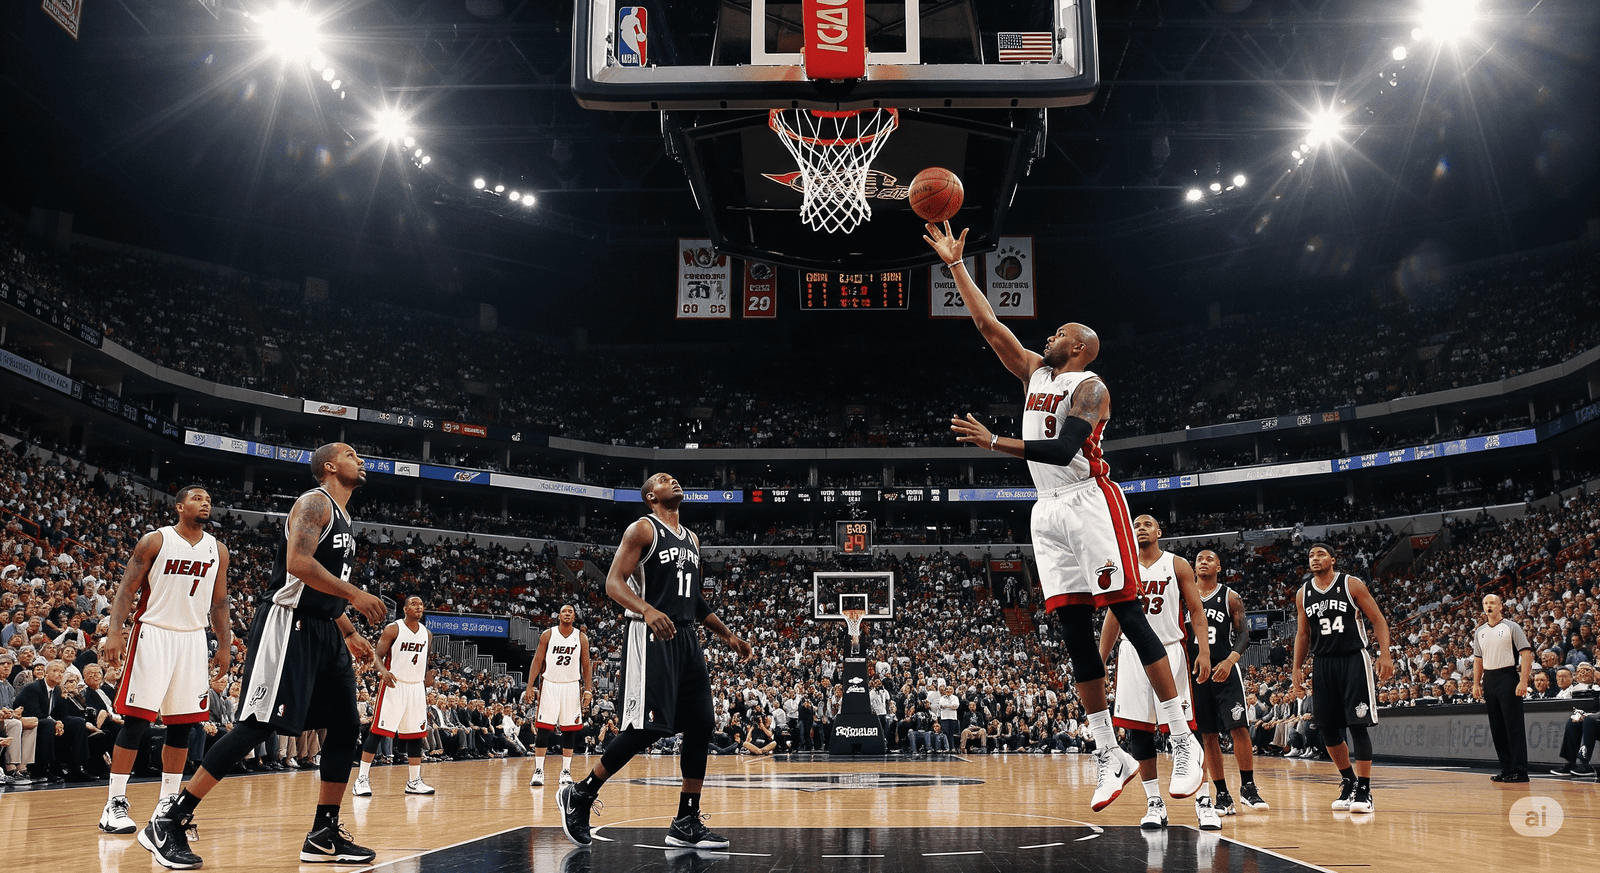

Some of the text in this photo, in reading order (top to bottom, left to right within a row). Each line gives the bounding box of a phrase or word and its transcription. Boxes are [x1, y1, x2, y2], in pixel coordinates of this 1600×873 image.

[999, 292, 1021, 307] 20
[1026, 390, 1068, 414] HEAT
[1044, 415, 1057, 438] 9
[163, 559, 216, 578] HEAT
[189, 579, 200, 597] 1
[677, 570, 692, 597] 11
[1305, 599, 1348, 618] SPURS
[1319, 616, 1345, 635] 34
[400, 640, 427, 652] HEAT
[552, 644, 578, 655] HEAT
[411, 653, 419, 665] 4
[556, 655, 572, 666] 23
